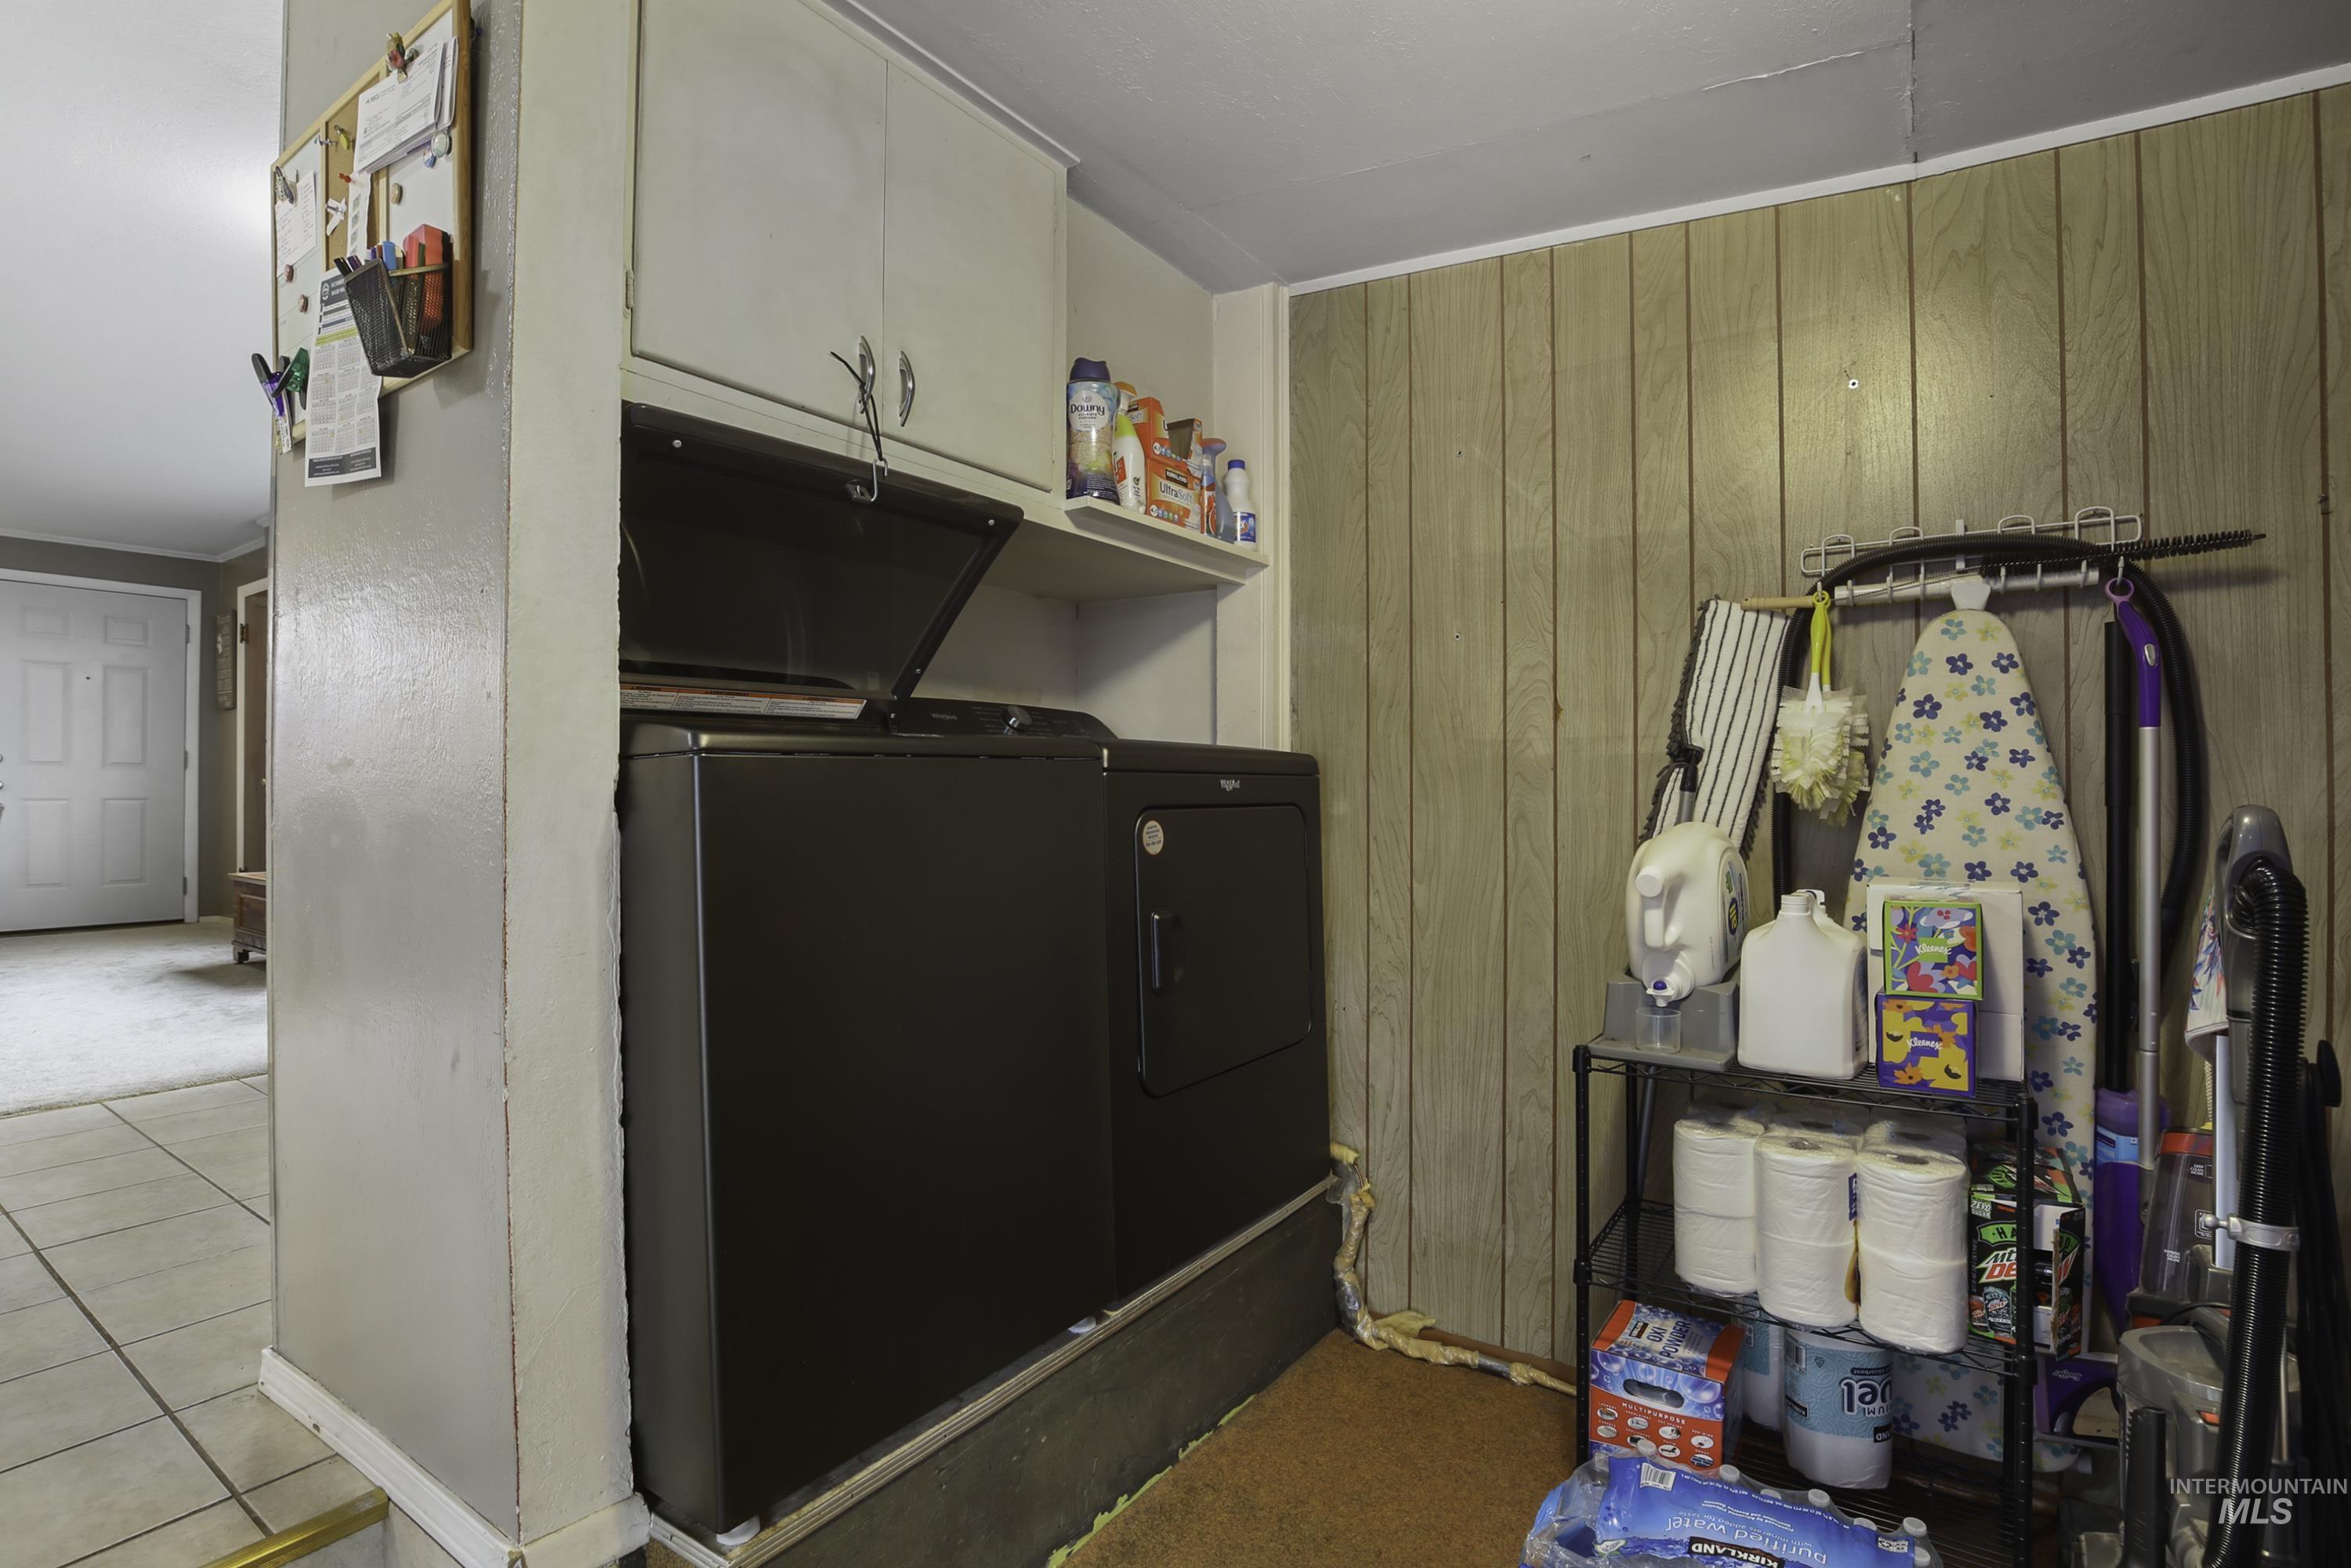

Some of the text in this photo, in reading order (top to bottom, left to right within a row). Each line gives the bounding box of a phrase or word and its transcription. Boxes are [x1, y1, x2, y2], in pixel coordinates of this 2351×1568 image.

[1070, 404, 1105, 416] Downy
[1914, 943, 1952, 955] Kleenex
[1907, 1037, 1943, 1050] Kleenex
[1970, 1200, 1991, 1213] ZERO
[1987, 1262, 2018, 1280] DE
[1646, 1327, 1668, 1342] OXI
[1659, 1320, 1692, 1359] POWDER
[1622, 1402, 1686, 1425] MULTIPURPOSE
[1704, 1514, 1715, 1523] for
[1718, 1518, 1746, 1530] added
[1665, 1515, 1828, 1566] purified water
[1748, 1526, 1788, 1542] minerals
[1791, 1538, 1812, 1547] with
[1691, 1542, 1779, 1568] KIRKLAND
